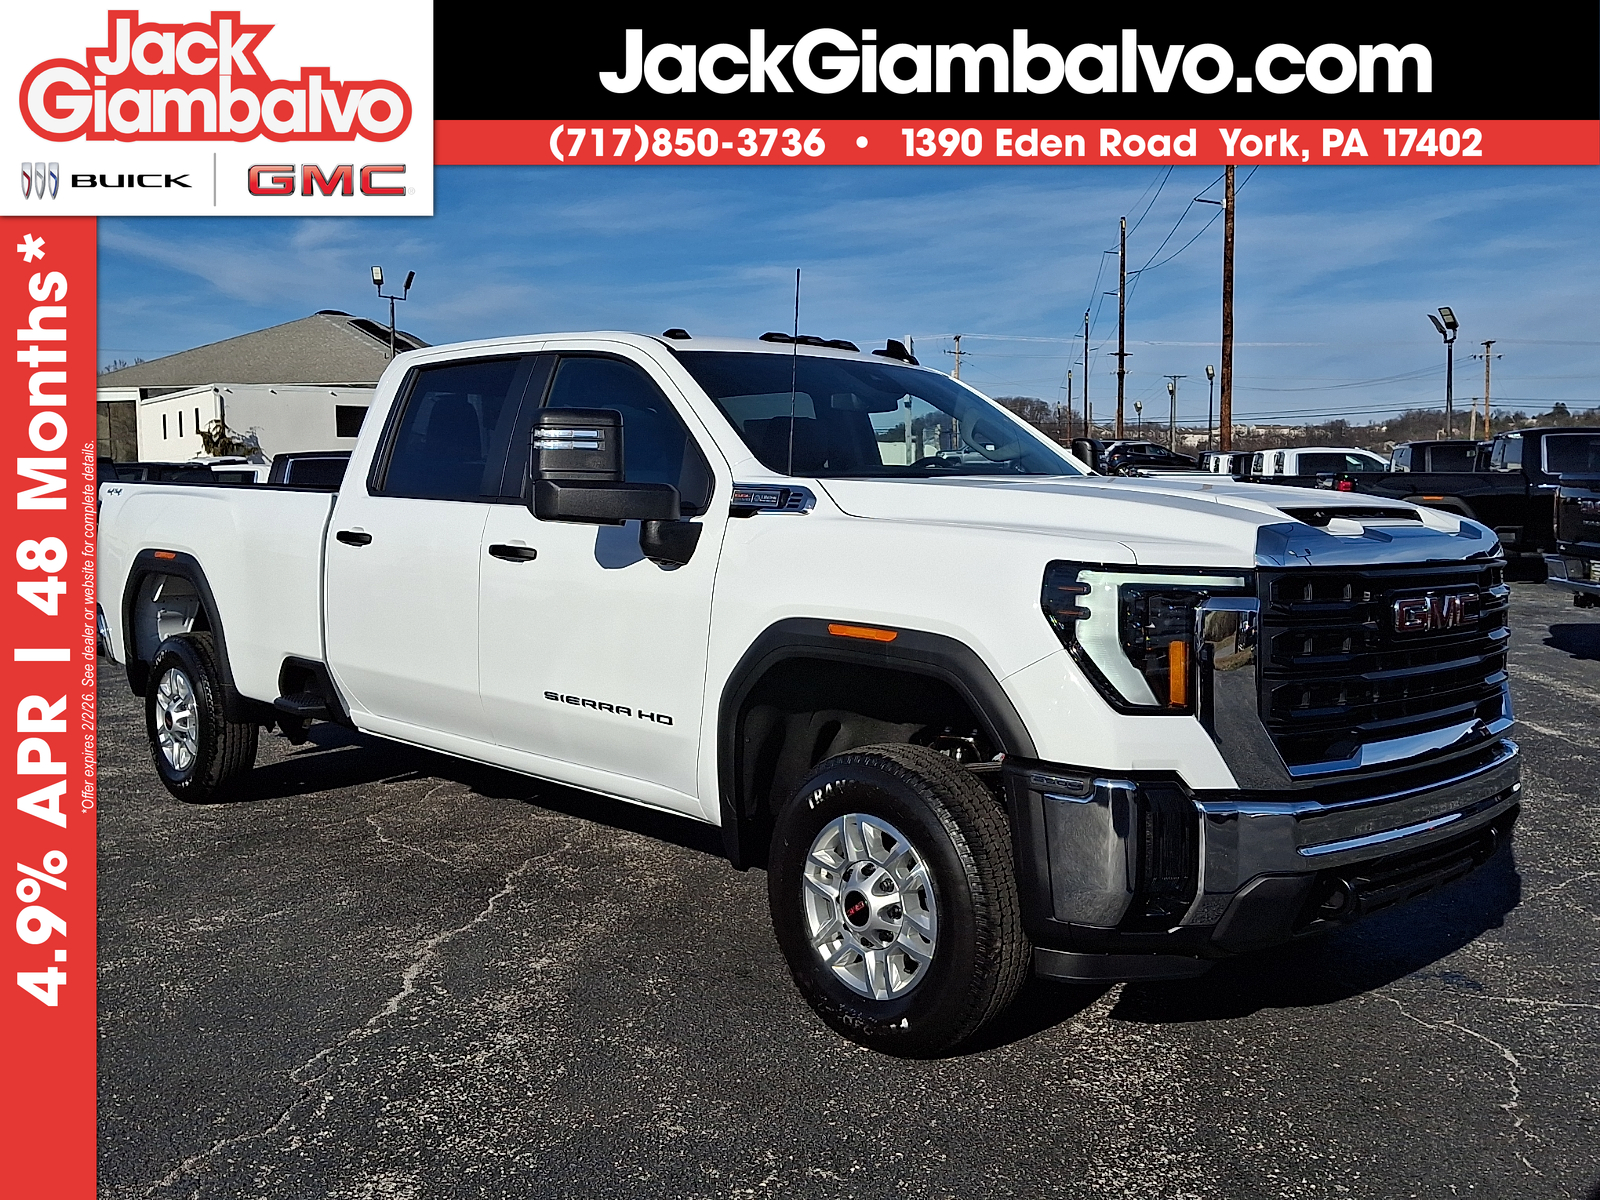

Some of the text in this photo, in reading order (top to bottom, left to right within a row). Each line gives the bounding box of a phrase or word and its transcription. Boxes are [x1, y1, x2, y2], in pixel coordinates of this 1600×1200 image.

[1394, 593, 1479, 633] GMC
[544, 691, 673, 726] SIERRA HD
